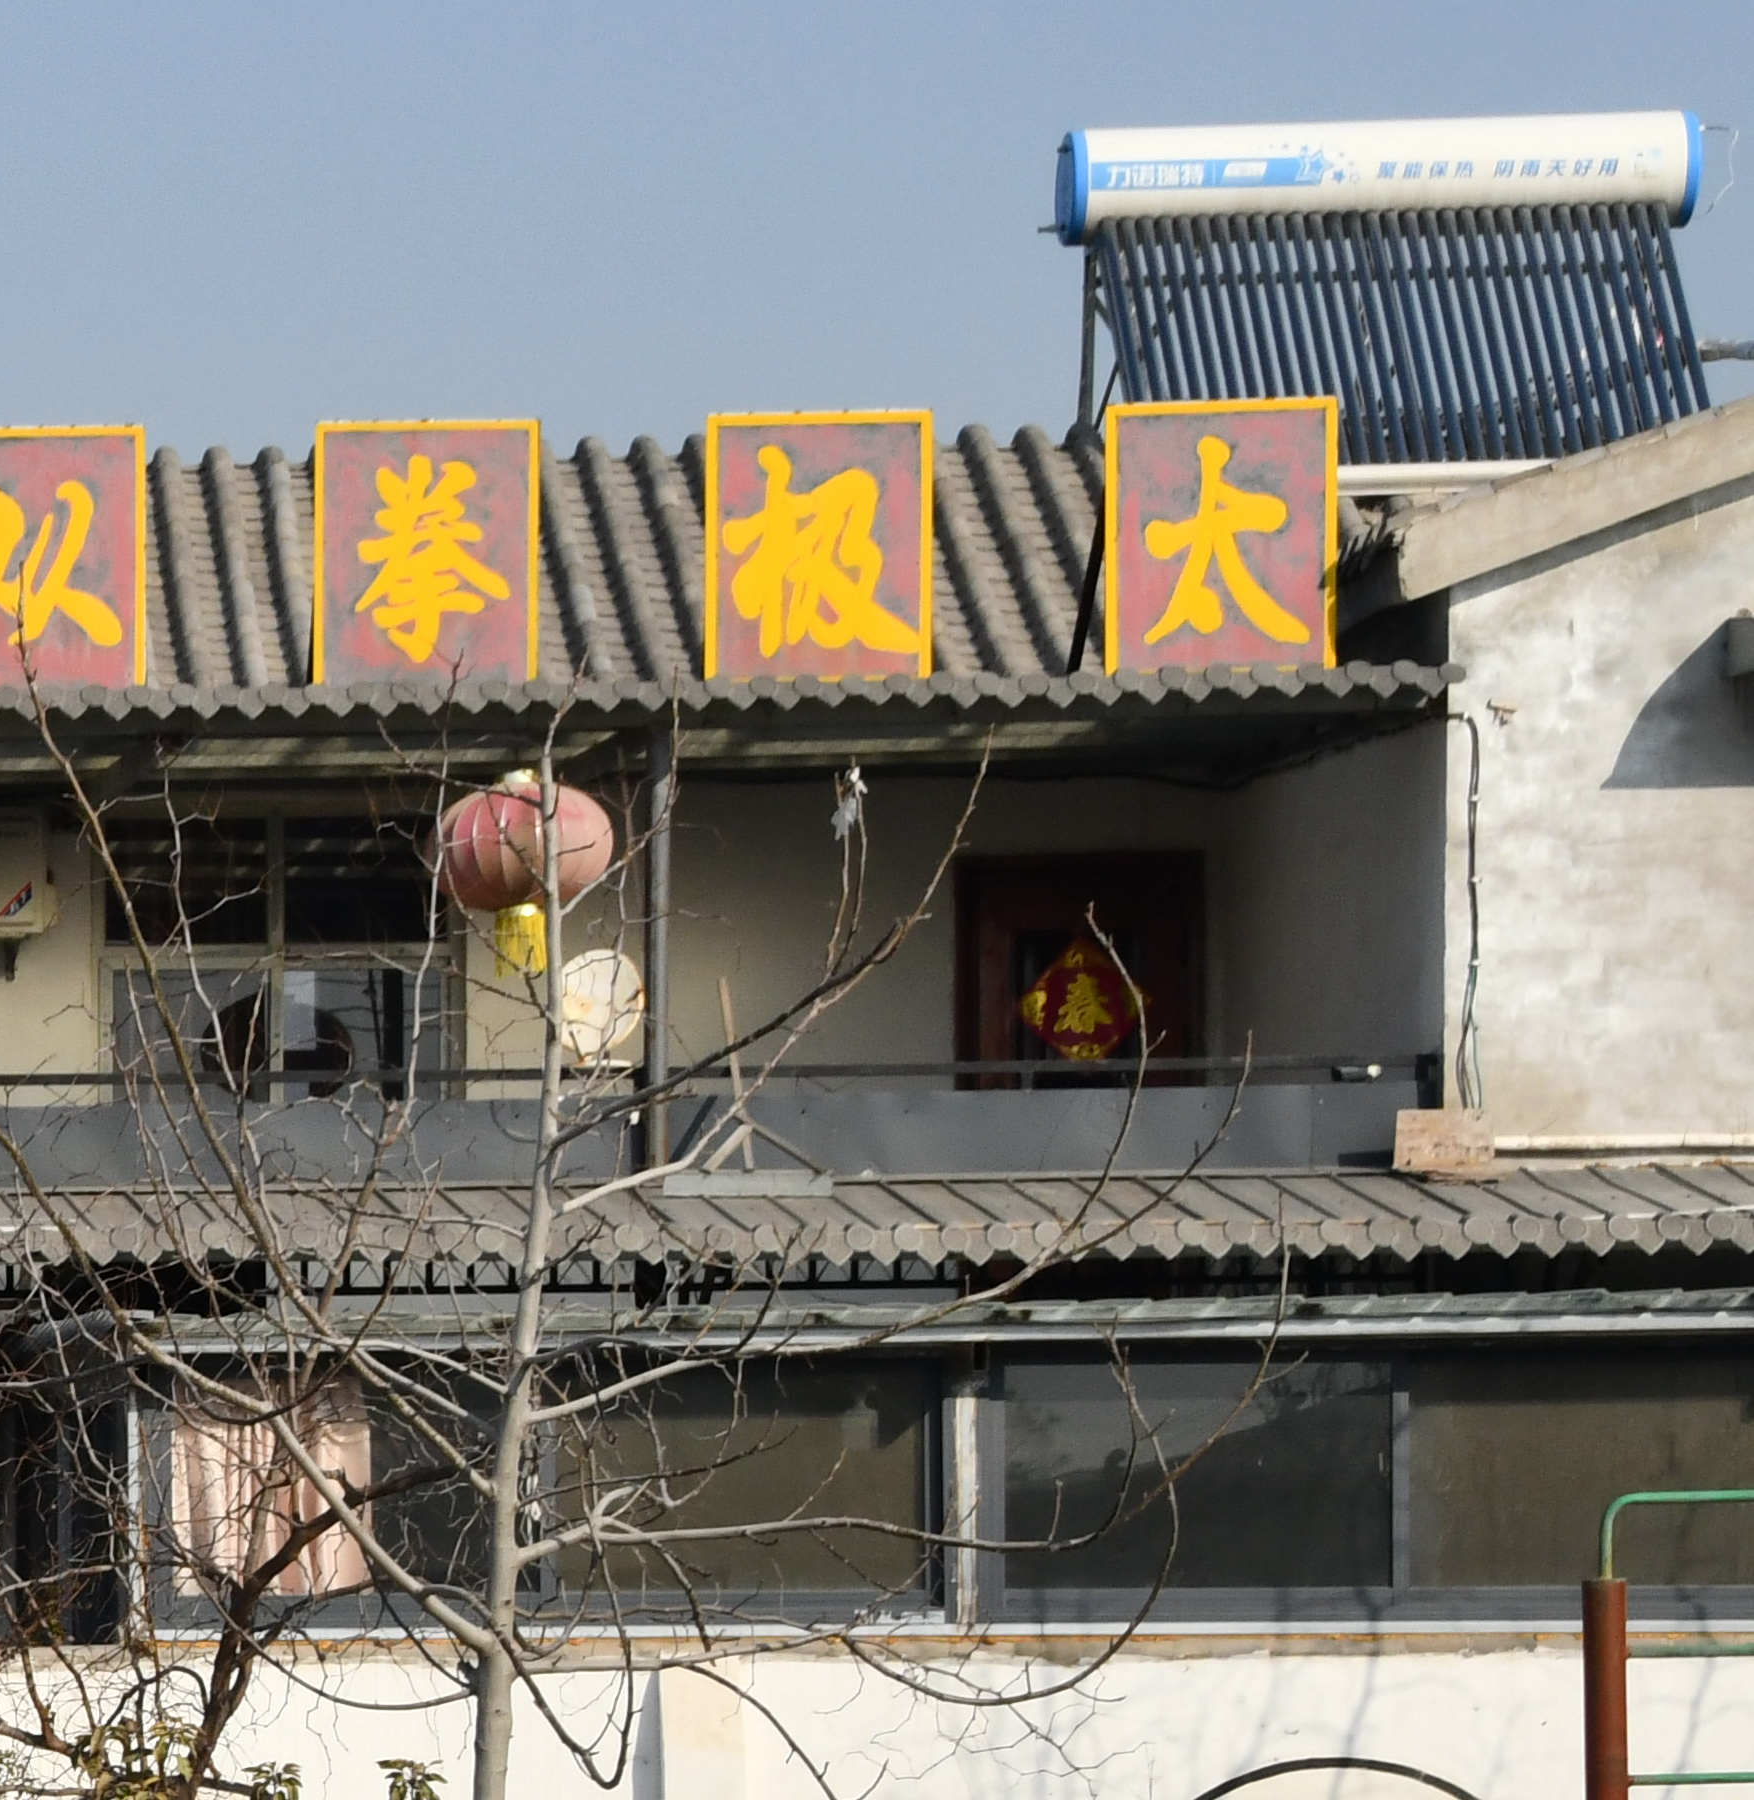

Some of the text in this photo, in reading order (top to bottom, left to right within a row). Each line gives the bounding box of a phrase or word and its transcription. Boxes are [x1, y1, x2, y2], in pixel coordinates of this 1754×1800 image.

[1493, 157, 1619, 178] 阴雨天好用
[357, 454, 510, 663] 拳
[722, 444, 922, 658] 极
[1145, 434, 1311, 644] 太
[1053, 973, 1114, 1034] 春
